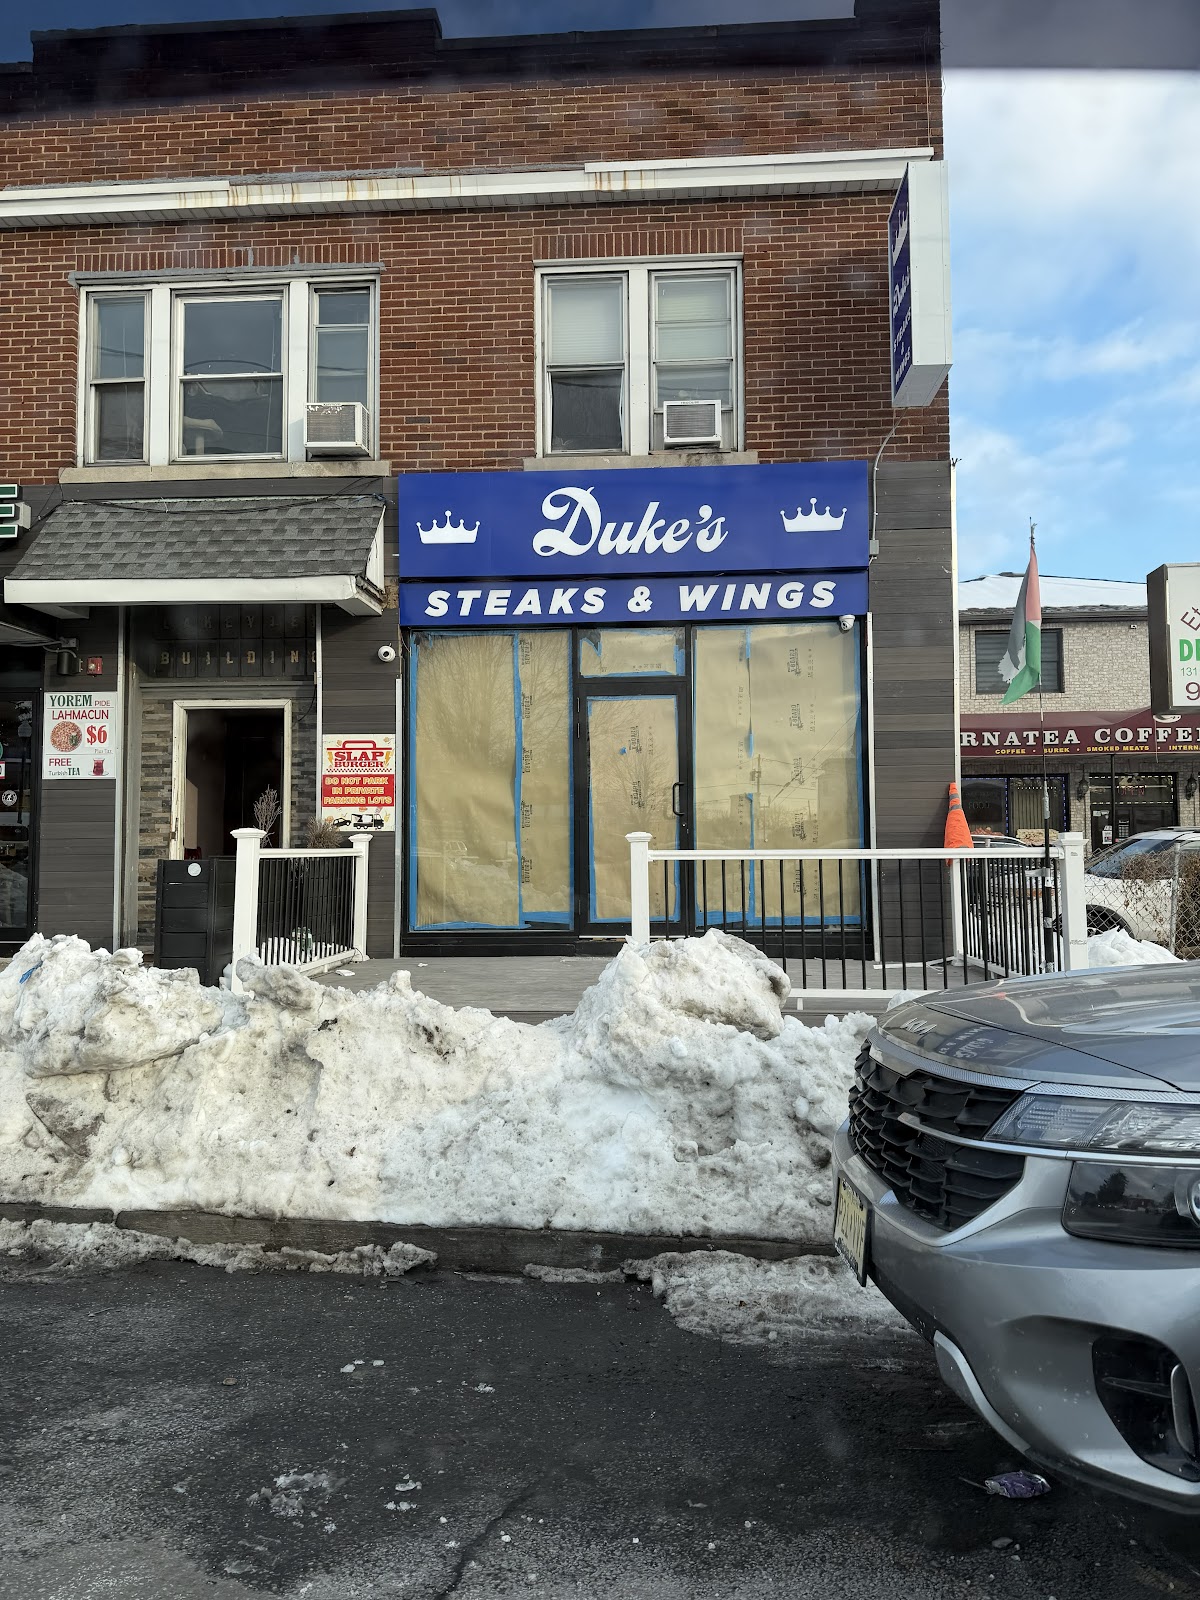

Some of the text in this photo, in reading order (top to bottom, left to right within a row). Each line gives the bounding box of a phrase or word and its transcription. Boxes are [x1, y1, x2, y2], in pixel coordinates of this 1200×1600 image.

[532, 485, 729, 557] Duke's
[424, 580, 837, 617] STEAKS & WINGS
[49, 694, 93, 707] YOREM
[52, 709, 109, 720] LAHMACUN
[86, 725, 108, 745] $6
[334, 751, 385, 761] SLAP
[48, 758, 72, 767] FREE
[68, 767, 80, 776] TEA
[324, 777, 388, 785] DO NOT PARK
[331, 786, 385, 795] IN PRIVATE
[323, 796, 392, 805] PARKING LOTS
